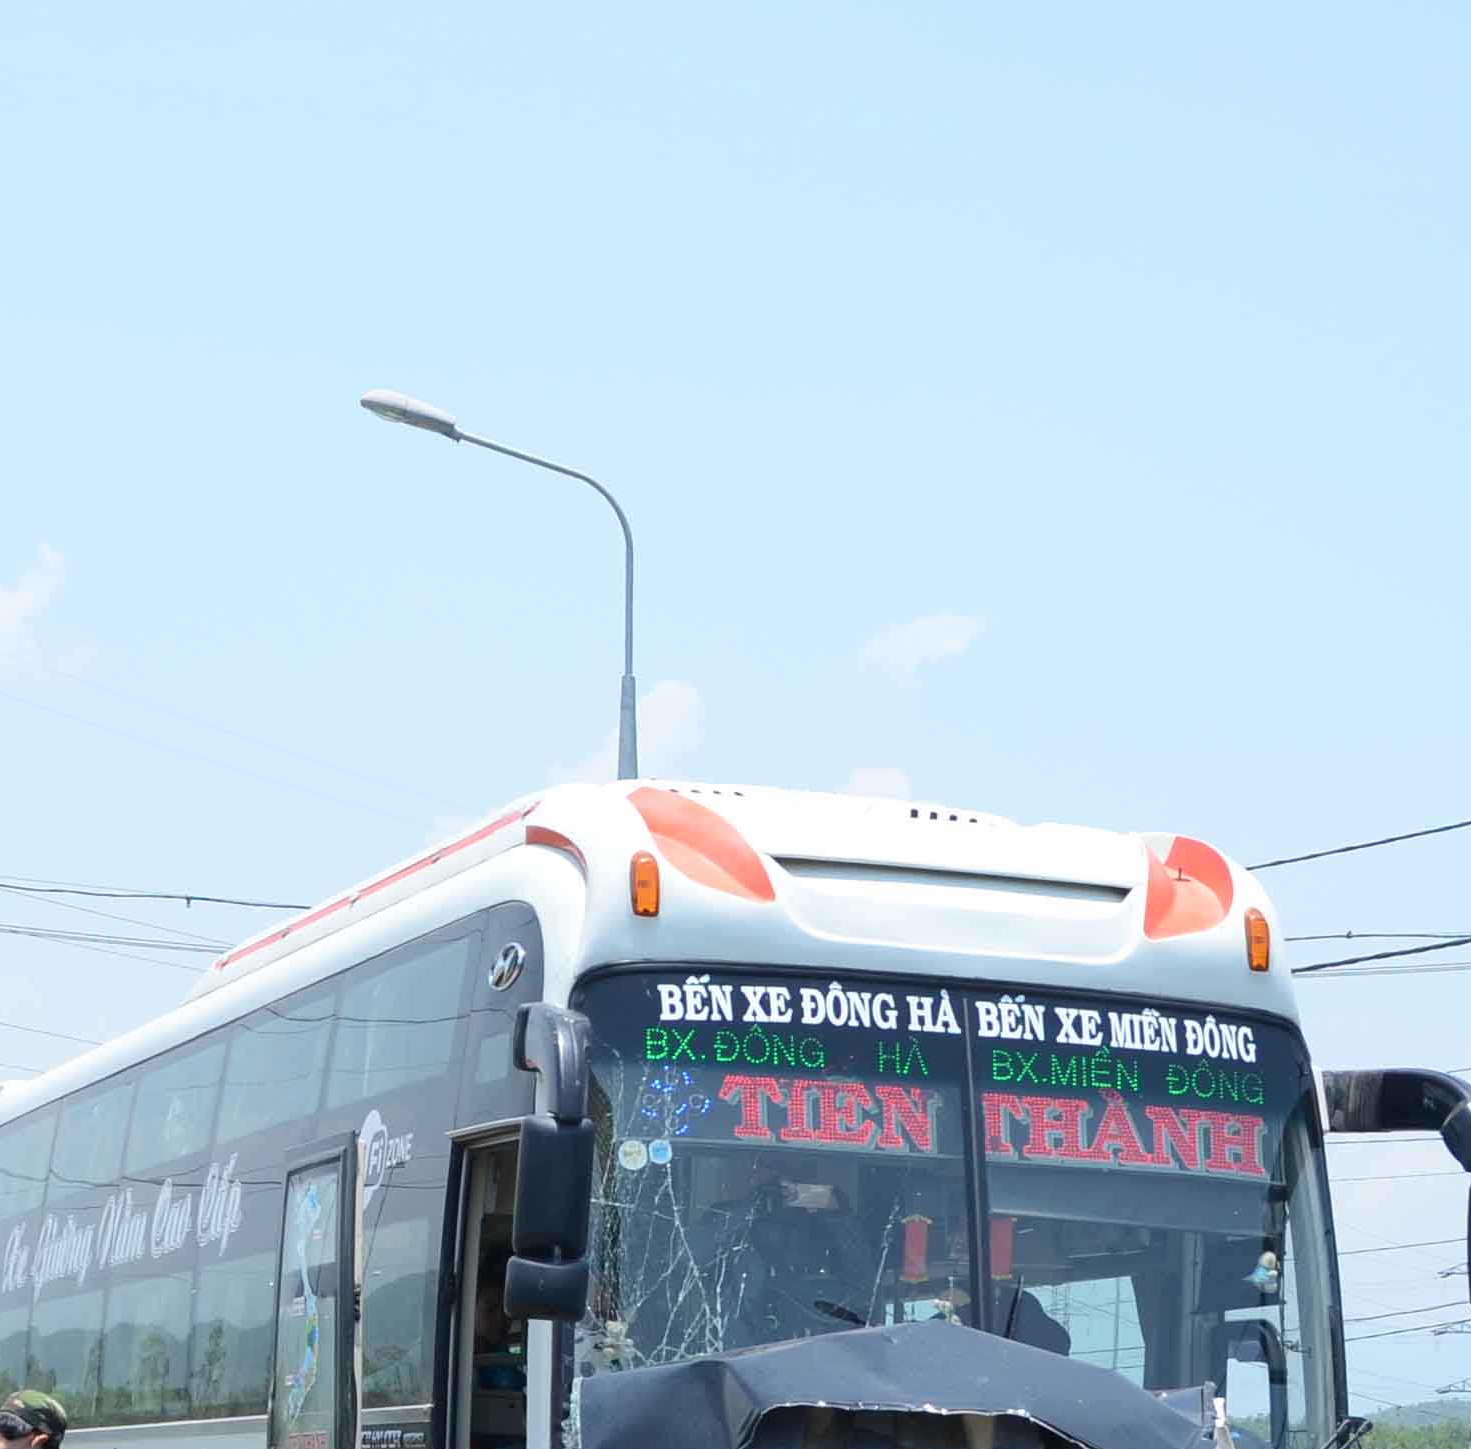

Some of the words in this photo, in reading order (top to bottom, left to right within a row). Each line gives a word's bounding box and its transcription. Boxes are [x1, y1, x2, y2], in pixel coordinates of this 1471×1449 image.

[657, 975, 733, 1021] BẾN
[740, 985, 792, 1023] XE
[800, 981, 898, 1030] ĐÔNG
[906, 988, 962, 1034] HÀ
[975, 994, 1045, 1041] BẾN
[1054, 1006, 1103, 1047] XE
[1108, 1008, 1178, 1054] MIỀN
[1184, 1014, 1256, 1063] ĐÔNG
[713, 1023, 826, 1068] ĐÔNG
[878, 1036, 929, 1077] HÀ
[1165, 1058, 1265, 1105] ĐÔNG
[981, 1088, 1265, 1176] THÀNH
